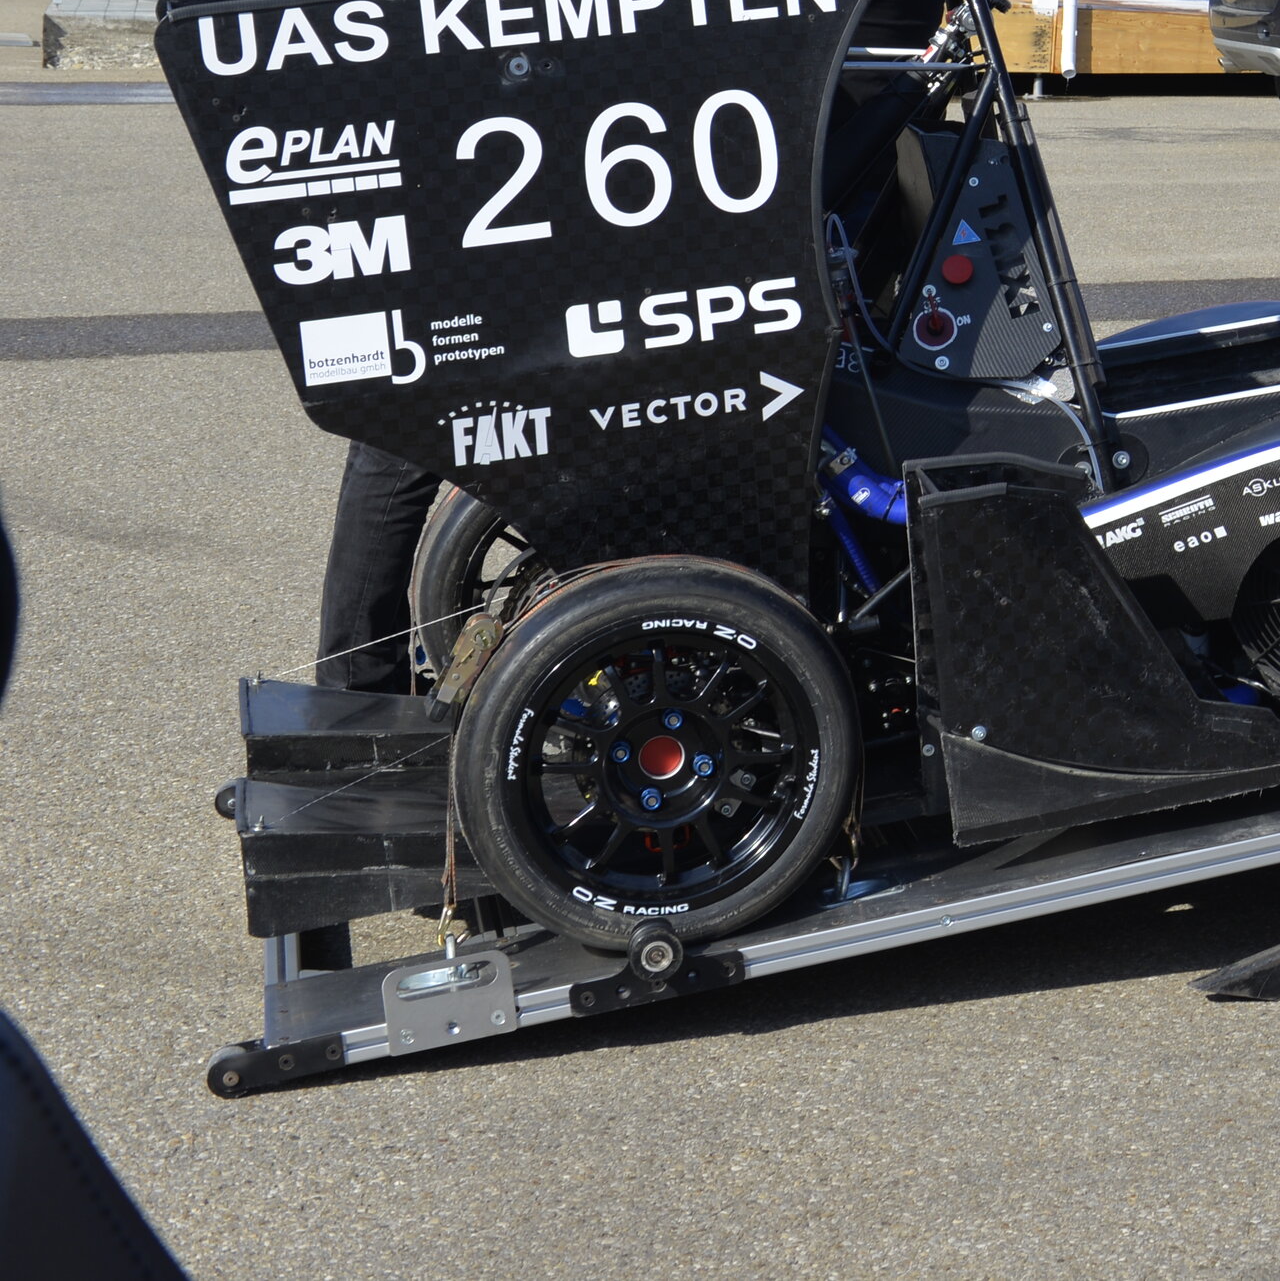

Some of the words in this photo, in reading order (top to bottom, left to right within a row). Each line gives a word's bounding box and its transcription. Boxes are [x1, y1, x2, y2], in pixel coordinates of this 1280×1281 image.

[197, 0, 390, 77] UAS
[455, 88, 780, 249] 260
[272, 214, 412, 285] 3M
[430, 314, 483, 330] modelle
[638, 276, 803, 351] SPS
[956, 314, 972, 327] ON
[432, 332, 479, 347] formen
[308, 349, 386, 370] botzenhardt
[433, 344, 505, 366] prototypen
[309, 364, 358, 381] modellbau
[589, 388, 747, 431] VECTOR
[641, 619, 708, 632] RACING
[622, 902, 690, 917] RACING
